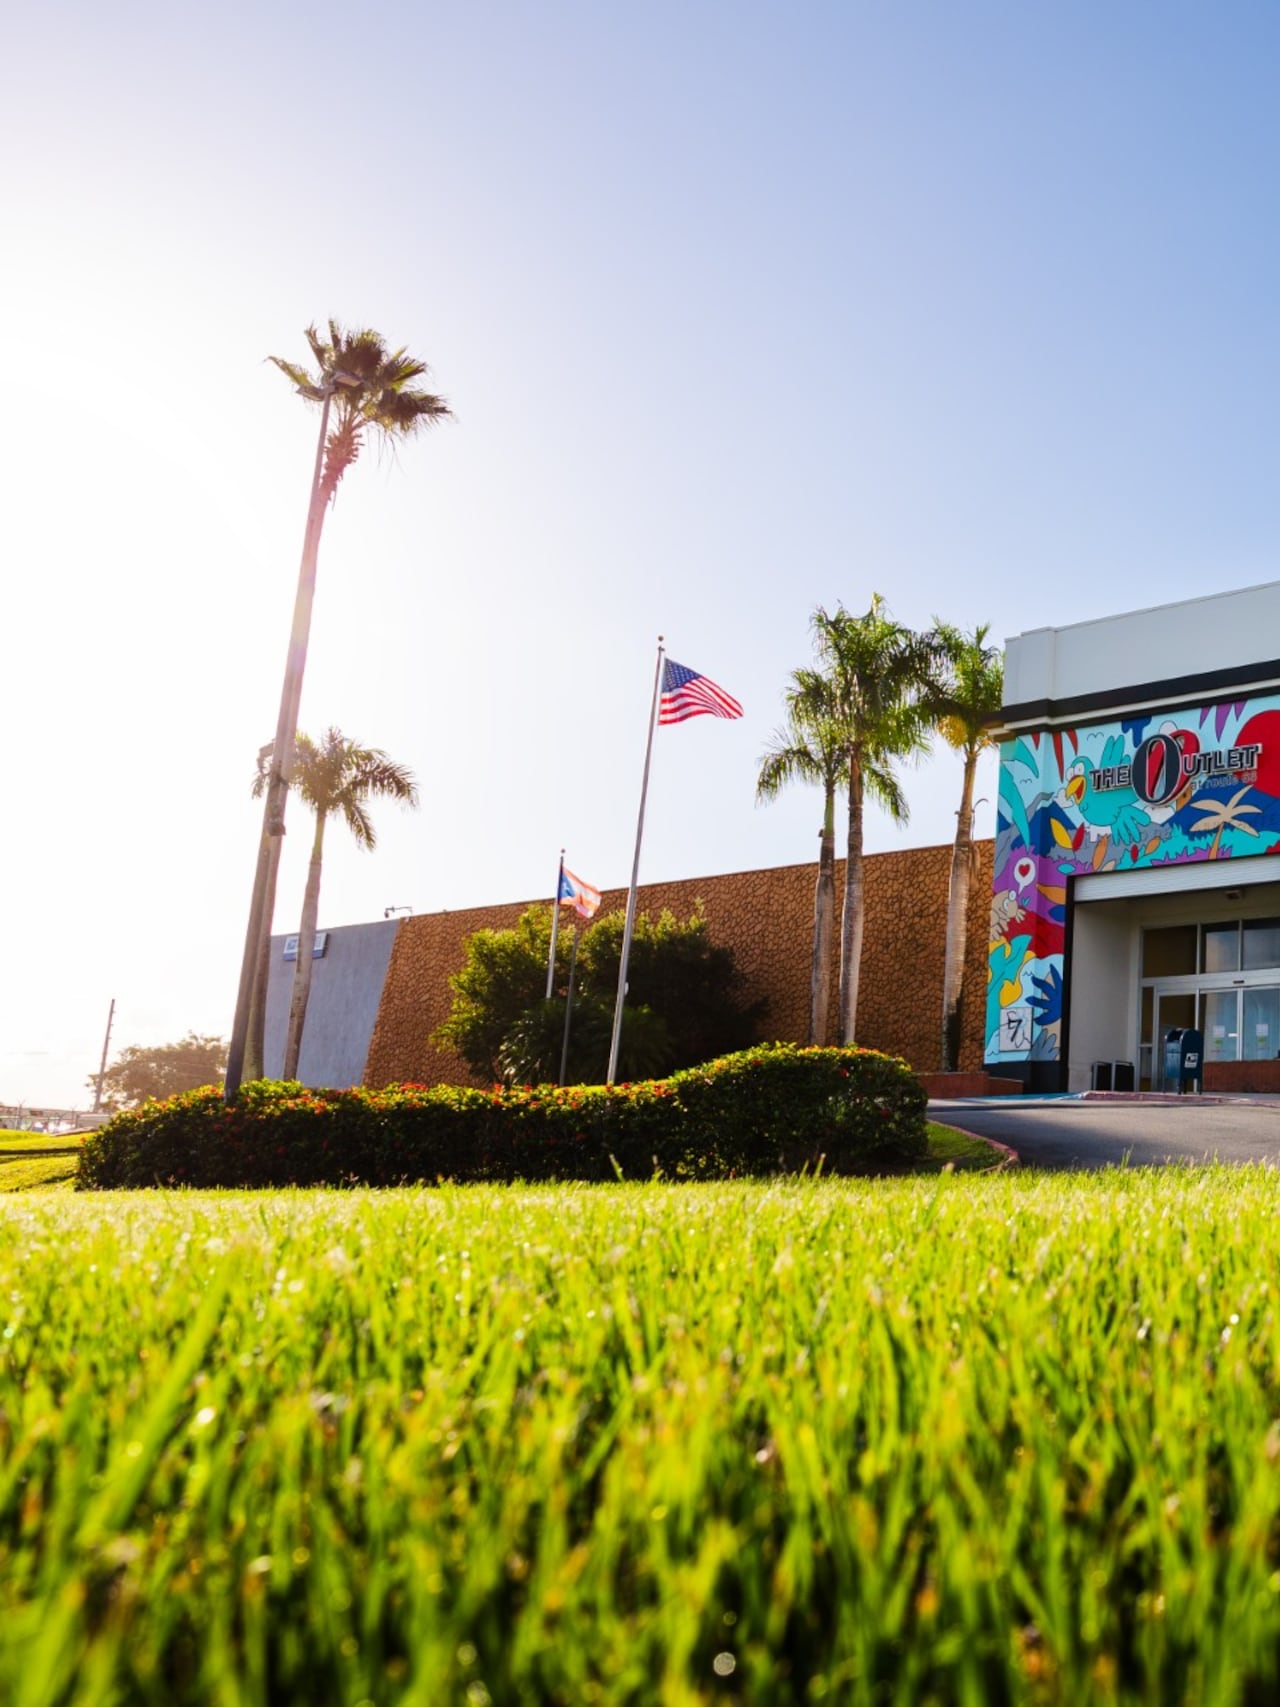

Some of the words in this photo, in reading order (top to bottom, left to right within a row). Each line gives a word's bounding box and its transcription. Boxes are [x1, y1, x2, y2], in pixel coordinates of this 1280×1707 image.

[1089, 764, 1132, 793] THE
[1131, 730, 1262, 806] OUTLET
[1008, 1018, 1023, 1042] 7
